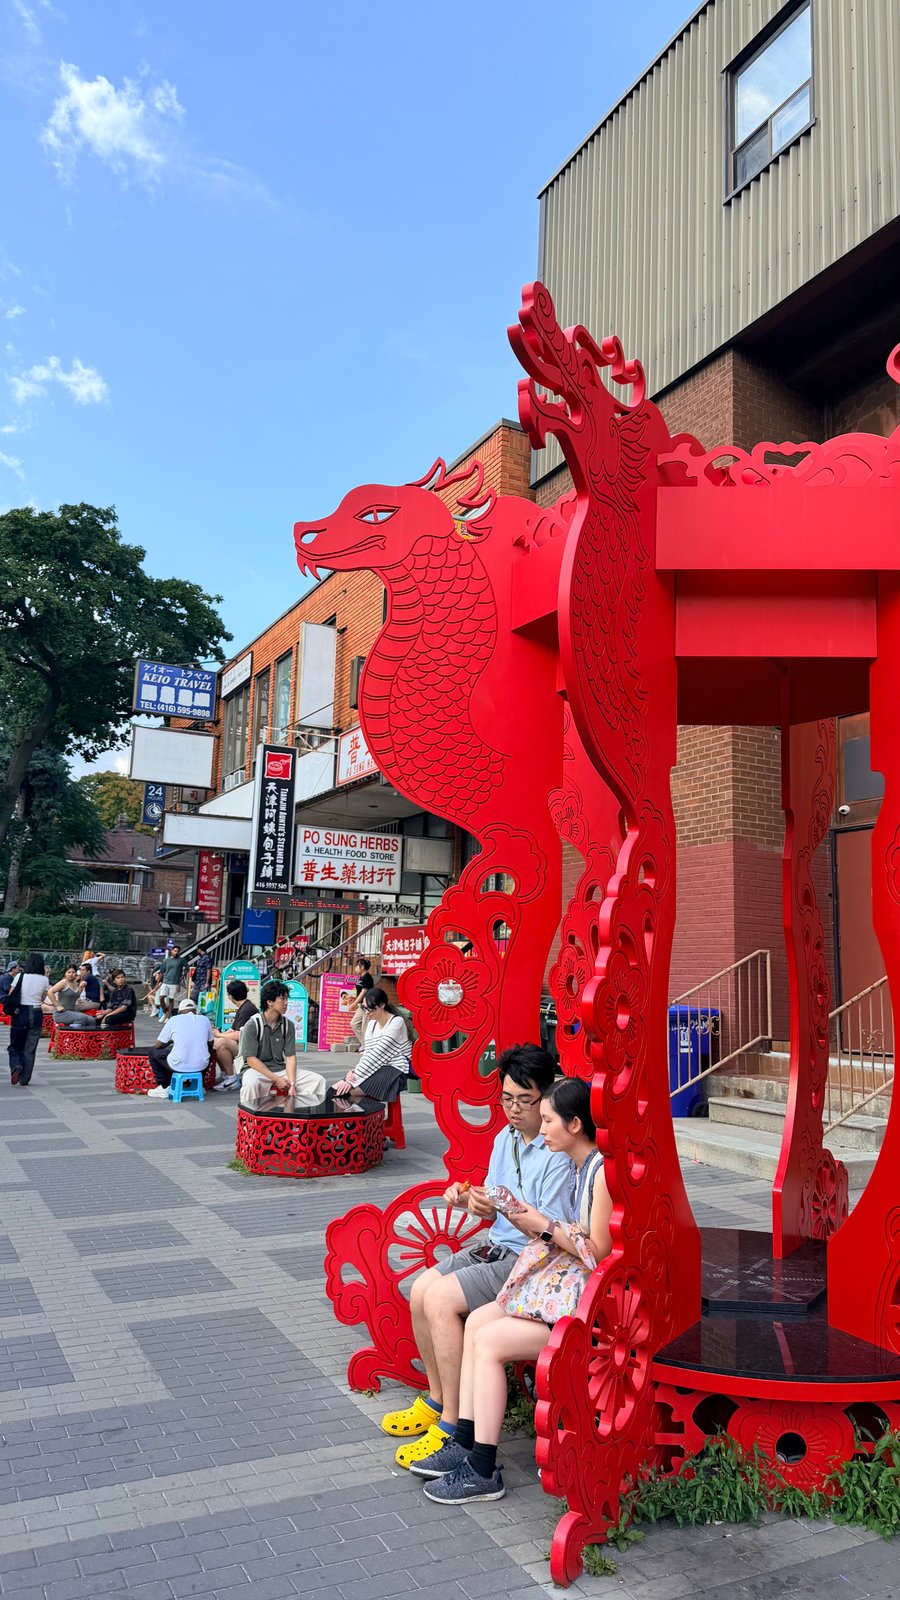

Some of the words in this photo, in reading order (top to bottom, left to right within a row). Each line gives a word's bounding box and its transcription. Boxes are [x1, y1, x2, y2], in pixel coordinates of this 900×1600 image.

[143, 664, 174, 675] ケイオー
[181, 669, 212, 681] トラベル
[142, 672, 171, 685] KEIO
[174, 677, 213, 692] TRAVEL
[140, 700, 157, 710] TEL:
[157, 703, 176, 713] (416)
[177, 706, 211, 718] 595-9898
[148, 785, 163, 797] 24
[303, 830, 320, 844] PO
[324, 832, 357, 848] SUNG
[360, 836, 399, 852] HERBS
[314, 846, 342, 856] HEALTH
[346, 849, 367, 858] FOOD
[370, 852, 395, 861] STORE
[301, 858, 396, 886] 普生藥材行
[484, 1051, 496, 1061] 75
